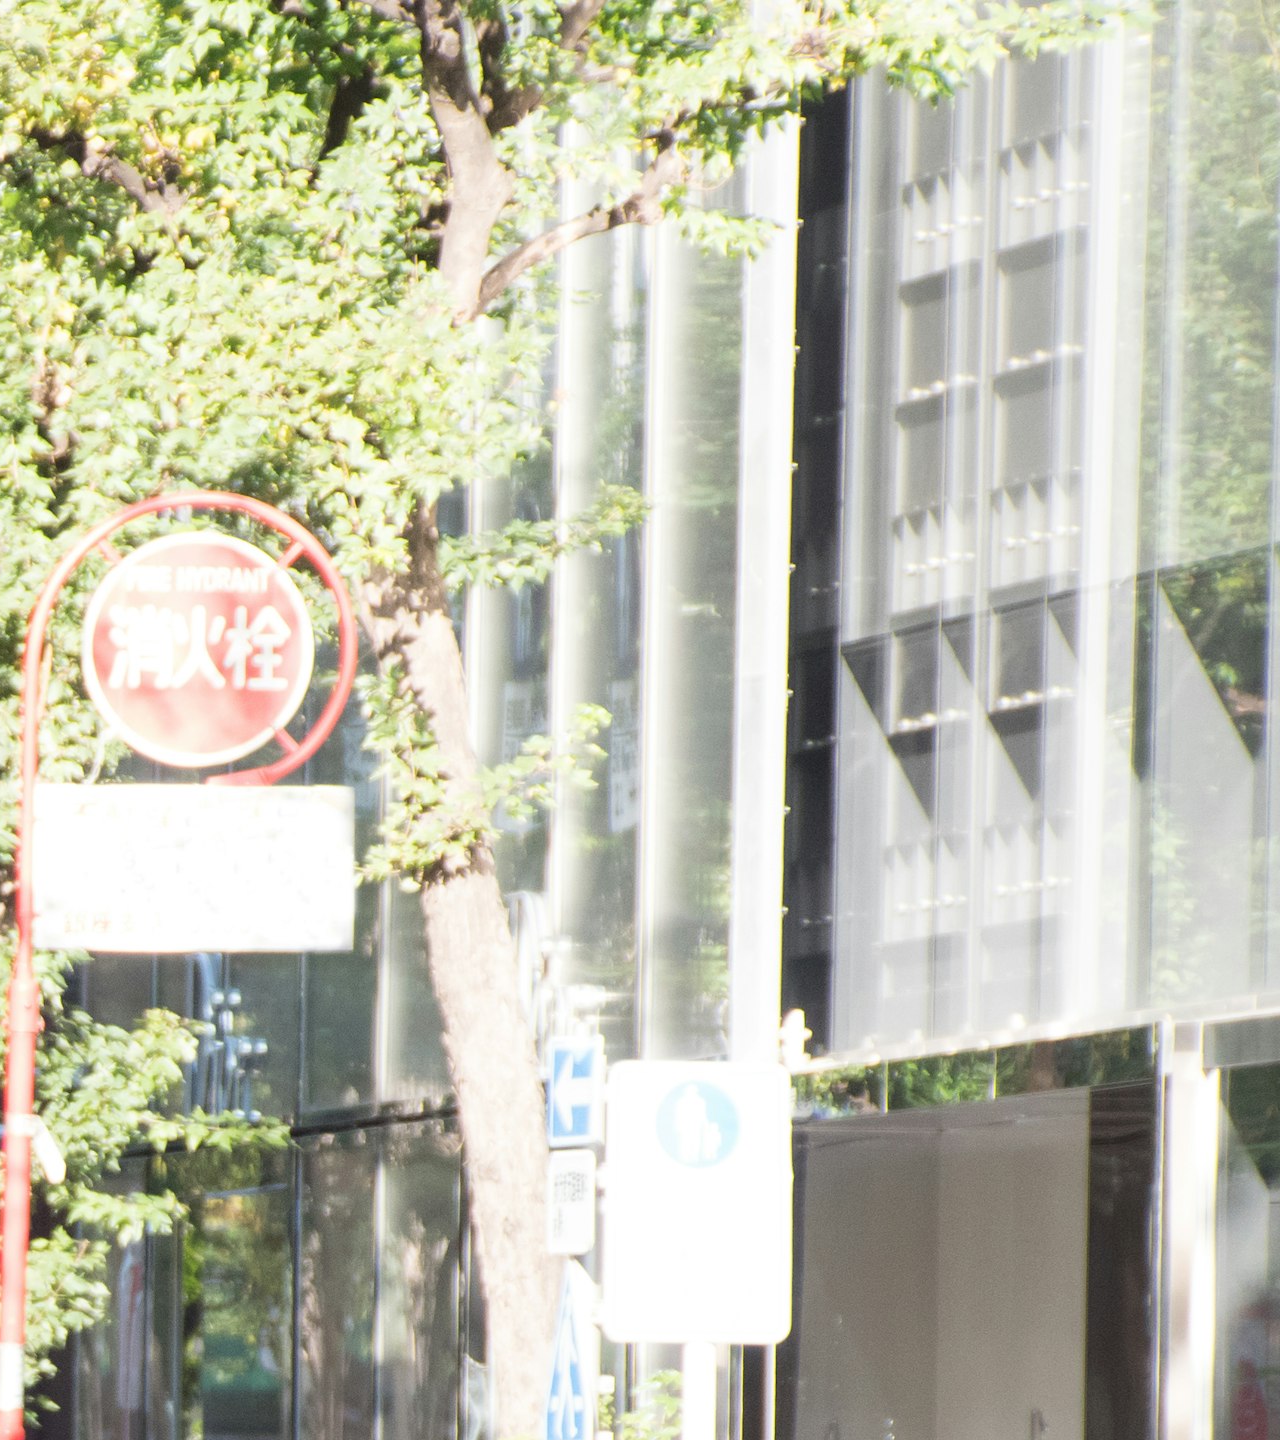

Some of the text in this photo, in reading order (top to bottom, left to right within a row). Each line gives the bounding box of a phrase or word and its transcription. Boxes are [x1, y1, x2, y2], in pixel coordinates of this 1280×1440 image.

[176, 566, 270, 592] HYDRANT
[107, 604, 293, 691] 消火栓
